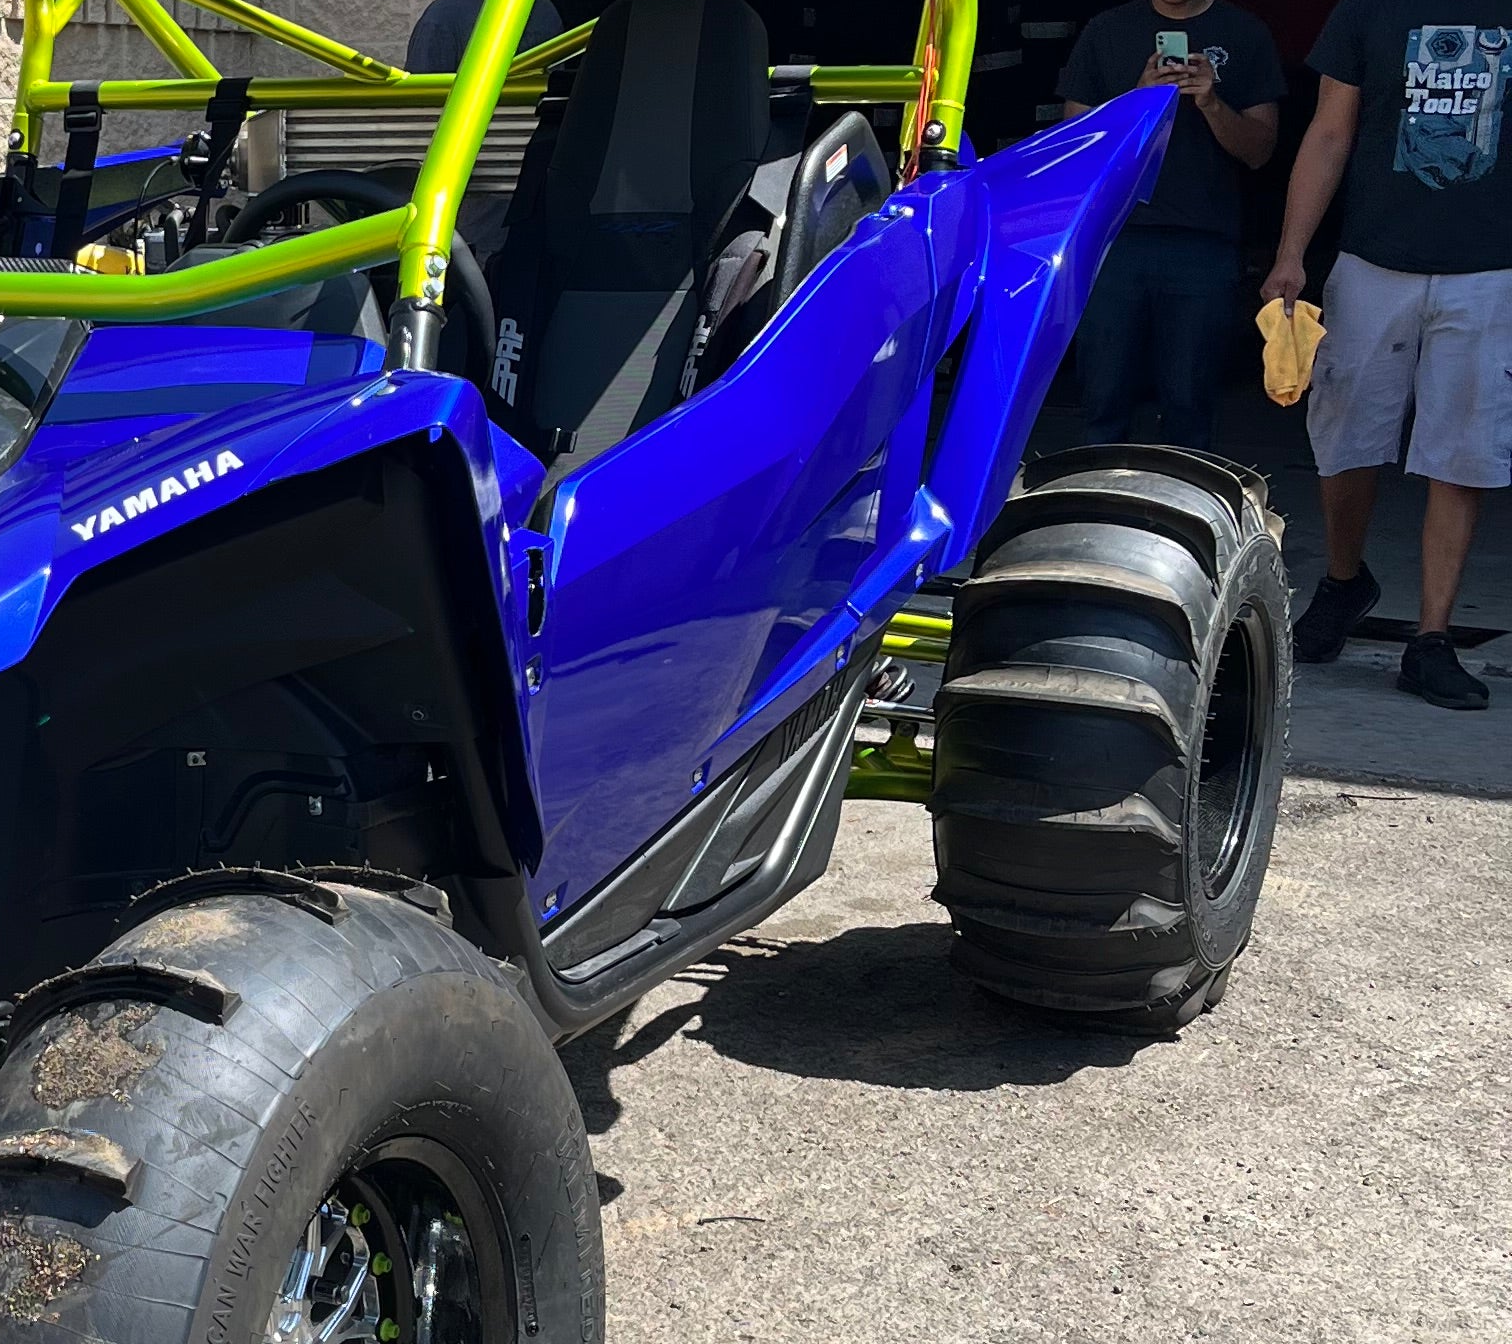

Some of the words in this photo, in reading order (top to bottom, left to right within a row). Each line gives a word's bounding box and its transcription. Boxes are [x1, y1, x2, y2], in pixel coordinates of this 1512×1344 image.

[1405, 61, 1492, 89] Matco
[1405, 88, 1478, 114] Tools
[492, 317, 524, 407] PRP
[70, 449, 245, 542] YAMAHA
[224, 1198, 263, 1284] WAR
[253, 1089, 316, 1215] FIGHTER
